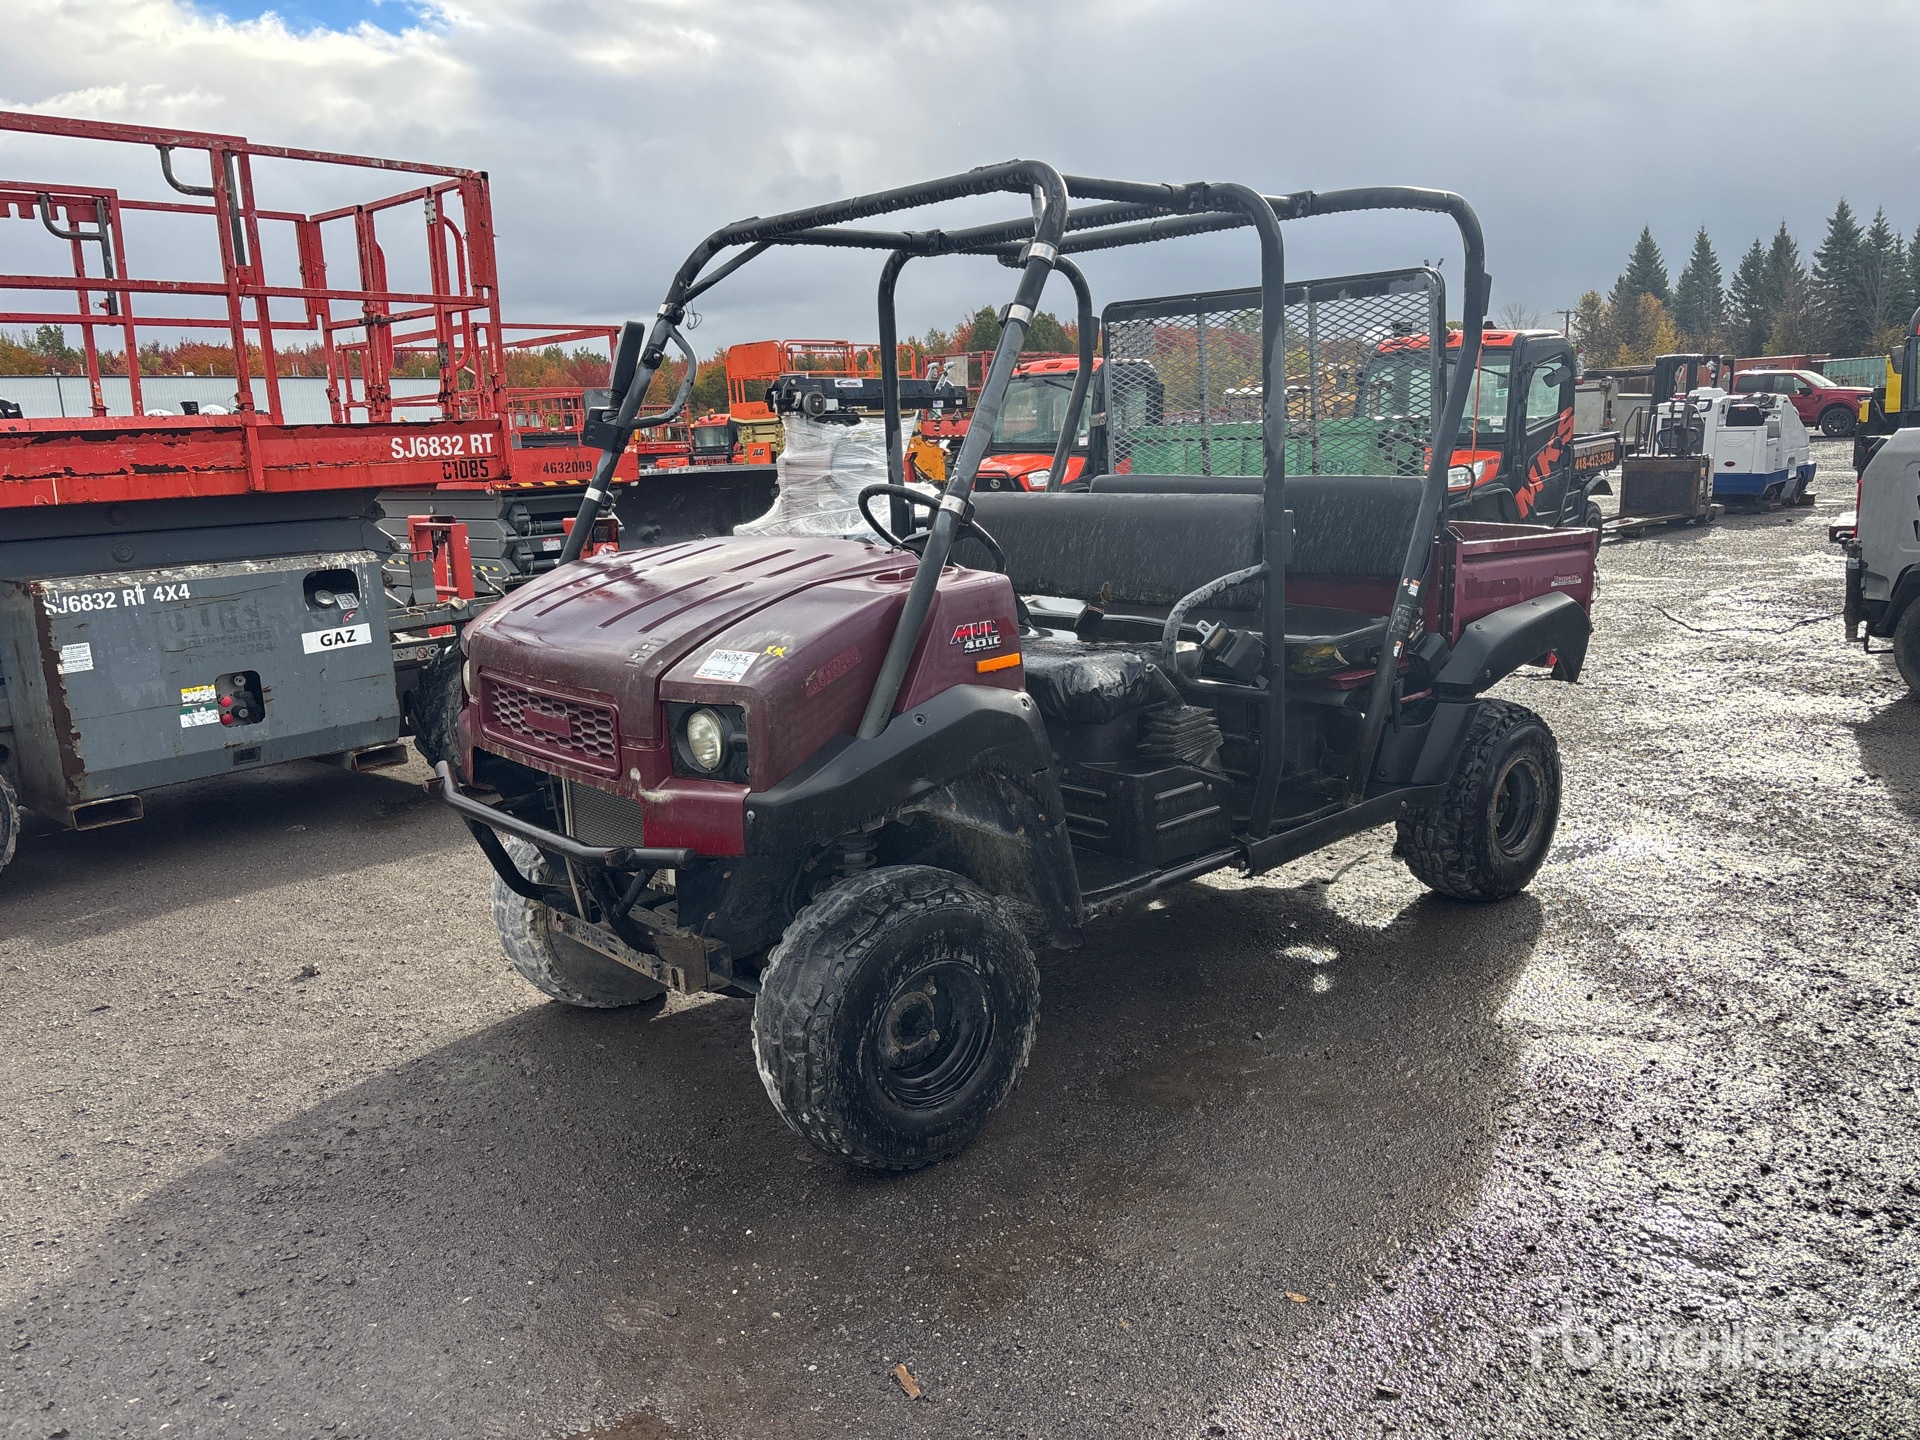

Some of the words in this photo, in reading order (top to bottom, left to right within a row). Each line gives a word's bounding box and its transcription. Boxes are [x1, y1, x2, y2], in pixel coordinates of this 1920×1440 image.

[391, 434, 464, 459] SJ6832
[470, 433, 493, 454] RT
[752, 447, 765, 457] JLG
[441, 459, 490, 480] C1085
[542, 460, 593, 474] 4632009
[1574, 451, 1615, 471] 418-412-3284
[43, 590, 118, 615] SJ6832
[122, 586, 146, 607] RT
[153, 583, 191, 602] 4X4
[320, 629, 357, 647] GAZ
